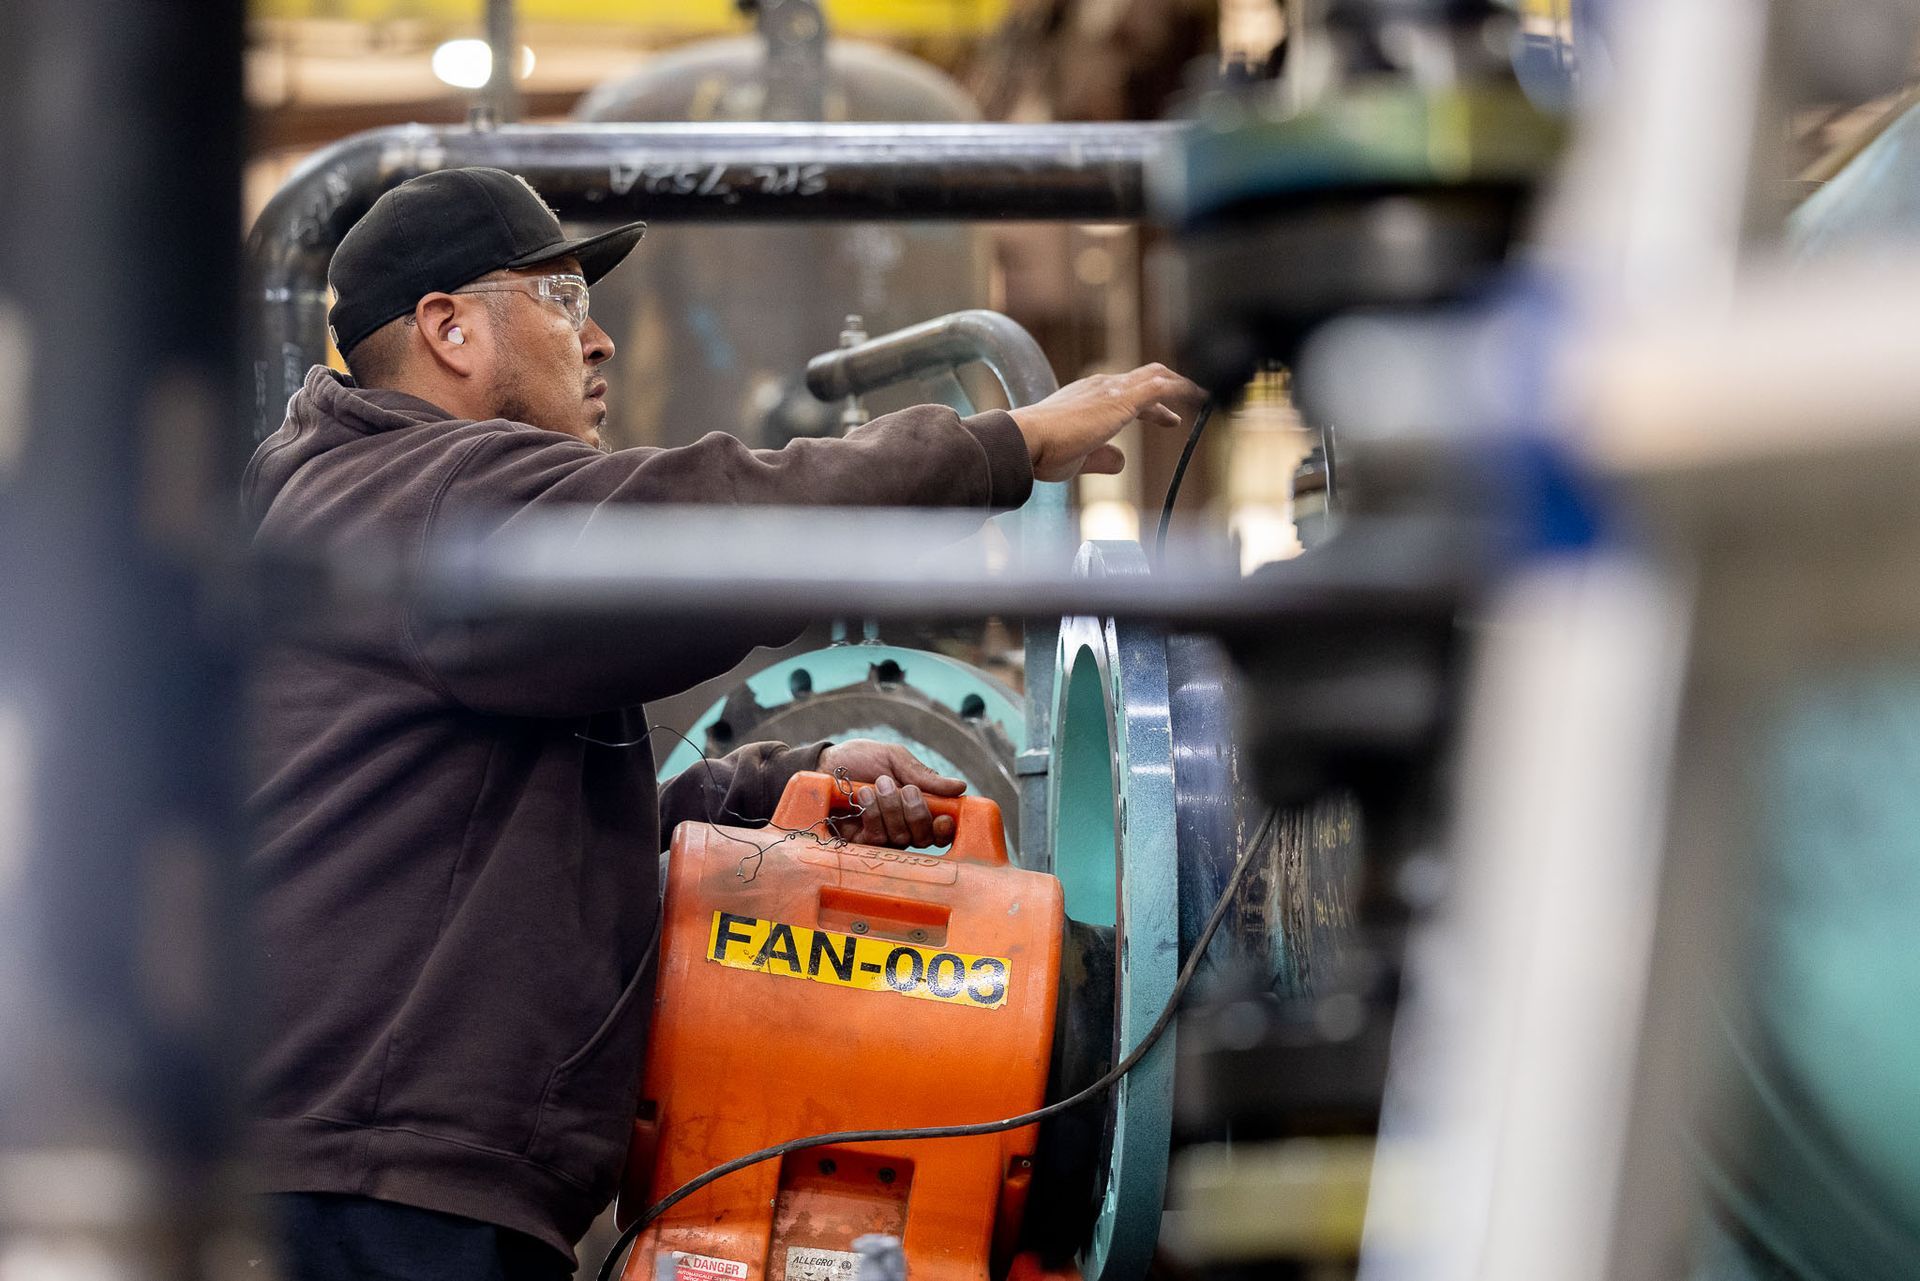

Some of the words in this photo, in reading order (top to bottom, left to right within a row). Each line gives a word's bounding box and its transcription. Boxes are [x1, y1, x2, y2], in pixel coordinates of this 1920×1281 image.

[714, 912, 1005, 1005] FAN-003
[693, 1257, 740, 1275] DANGER
[793, 1255, 833, 1267] ALLEGRO
